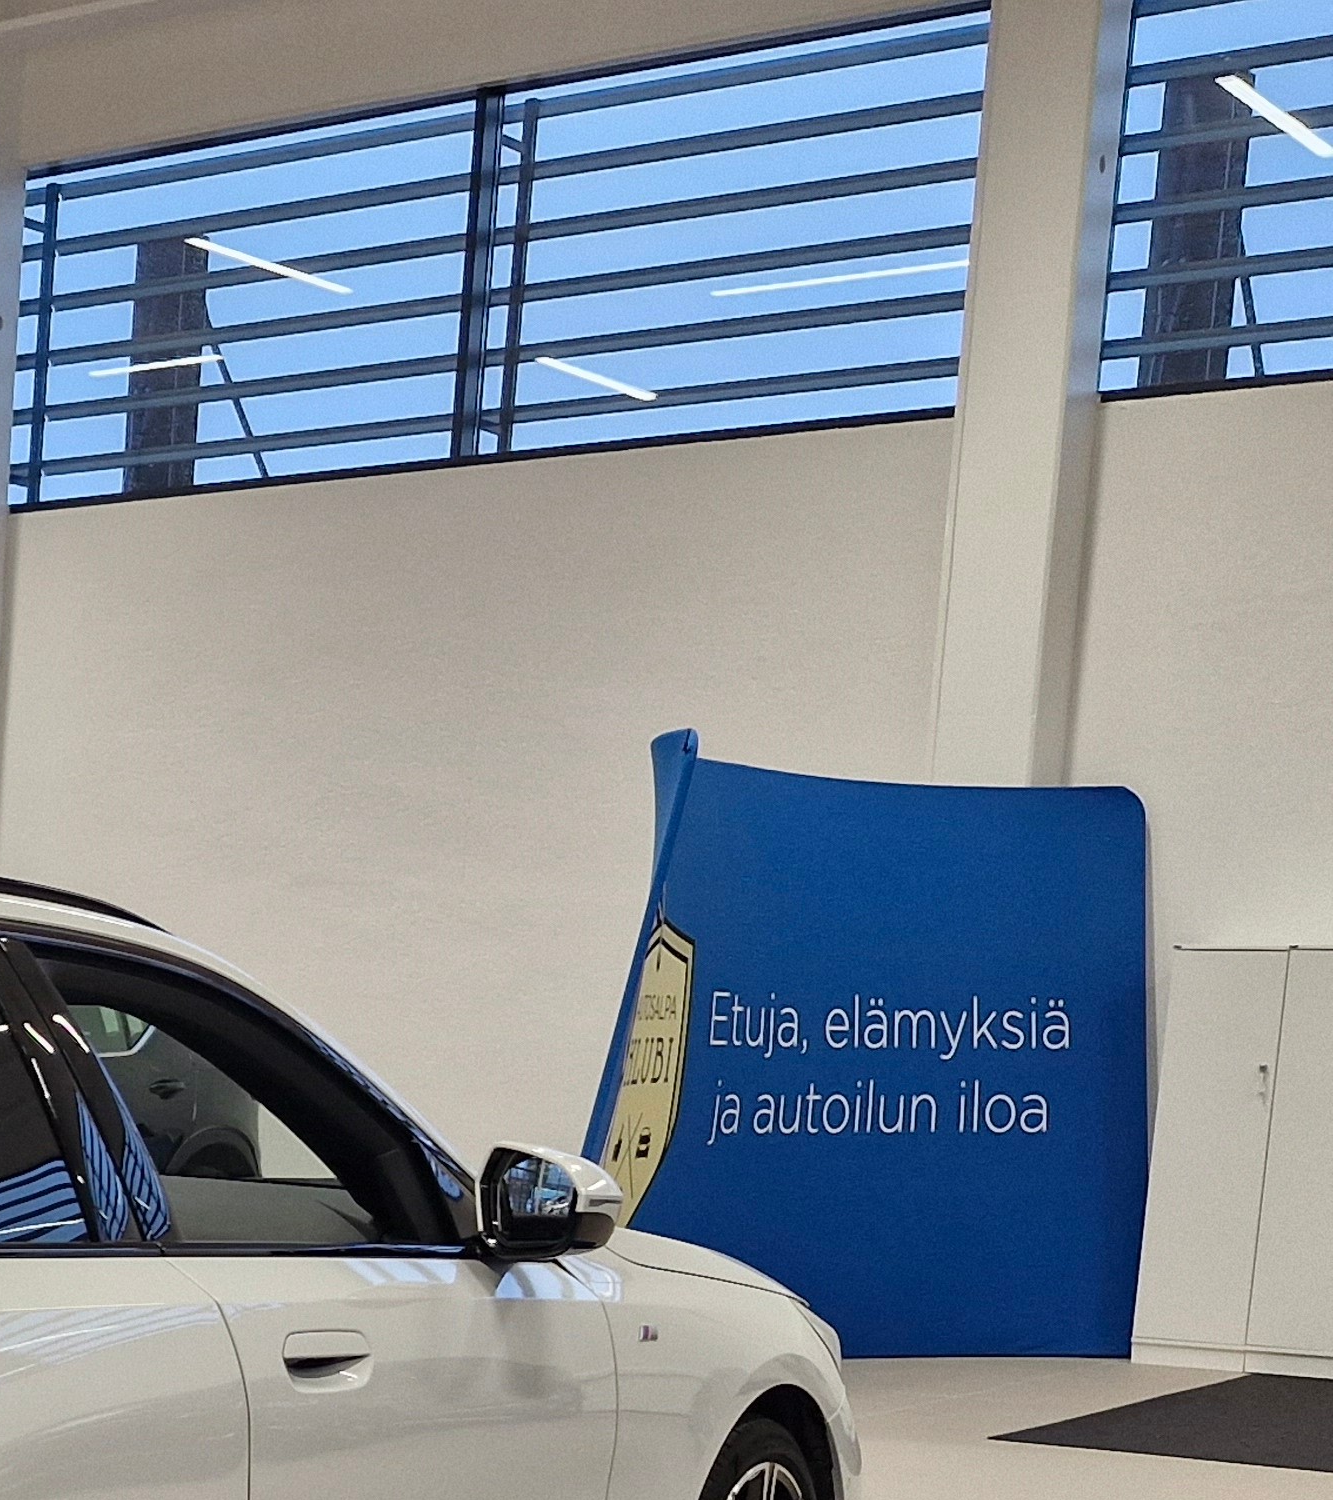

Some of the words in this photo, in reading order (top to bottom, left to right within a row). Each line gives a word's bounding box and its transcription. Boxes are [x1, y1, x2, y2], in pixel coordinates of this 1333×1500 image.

[708, 990, 809, 1059] Etuja,
[823, 993, 1072, 1061] elämyksiä
[706, 1078, 741, 1146] ja
[752, 1078, 938, 1135] autoilun
[958, 1078, 1050, 1134] iloa
